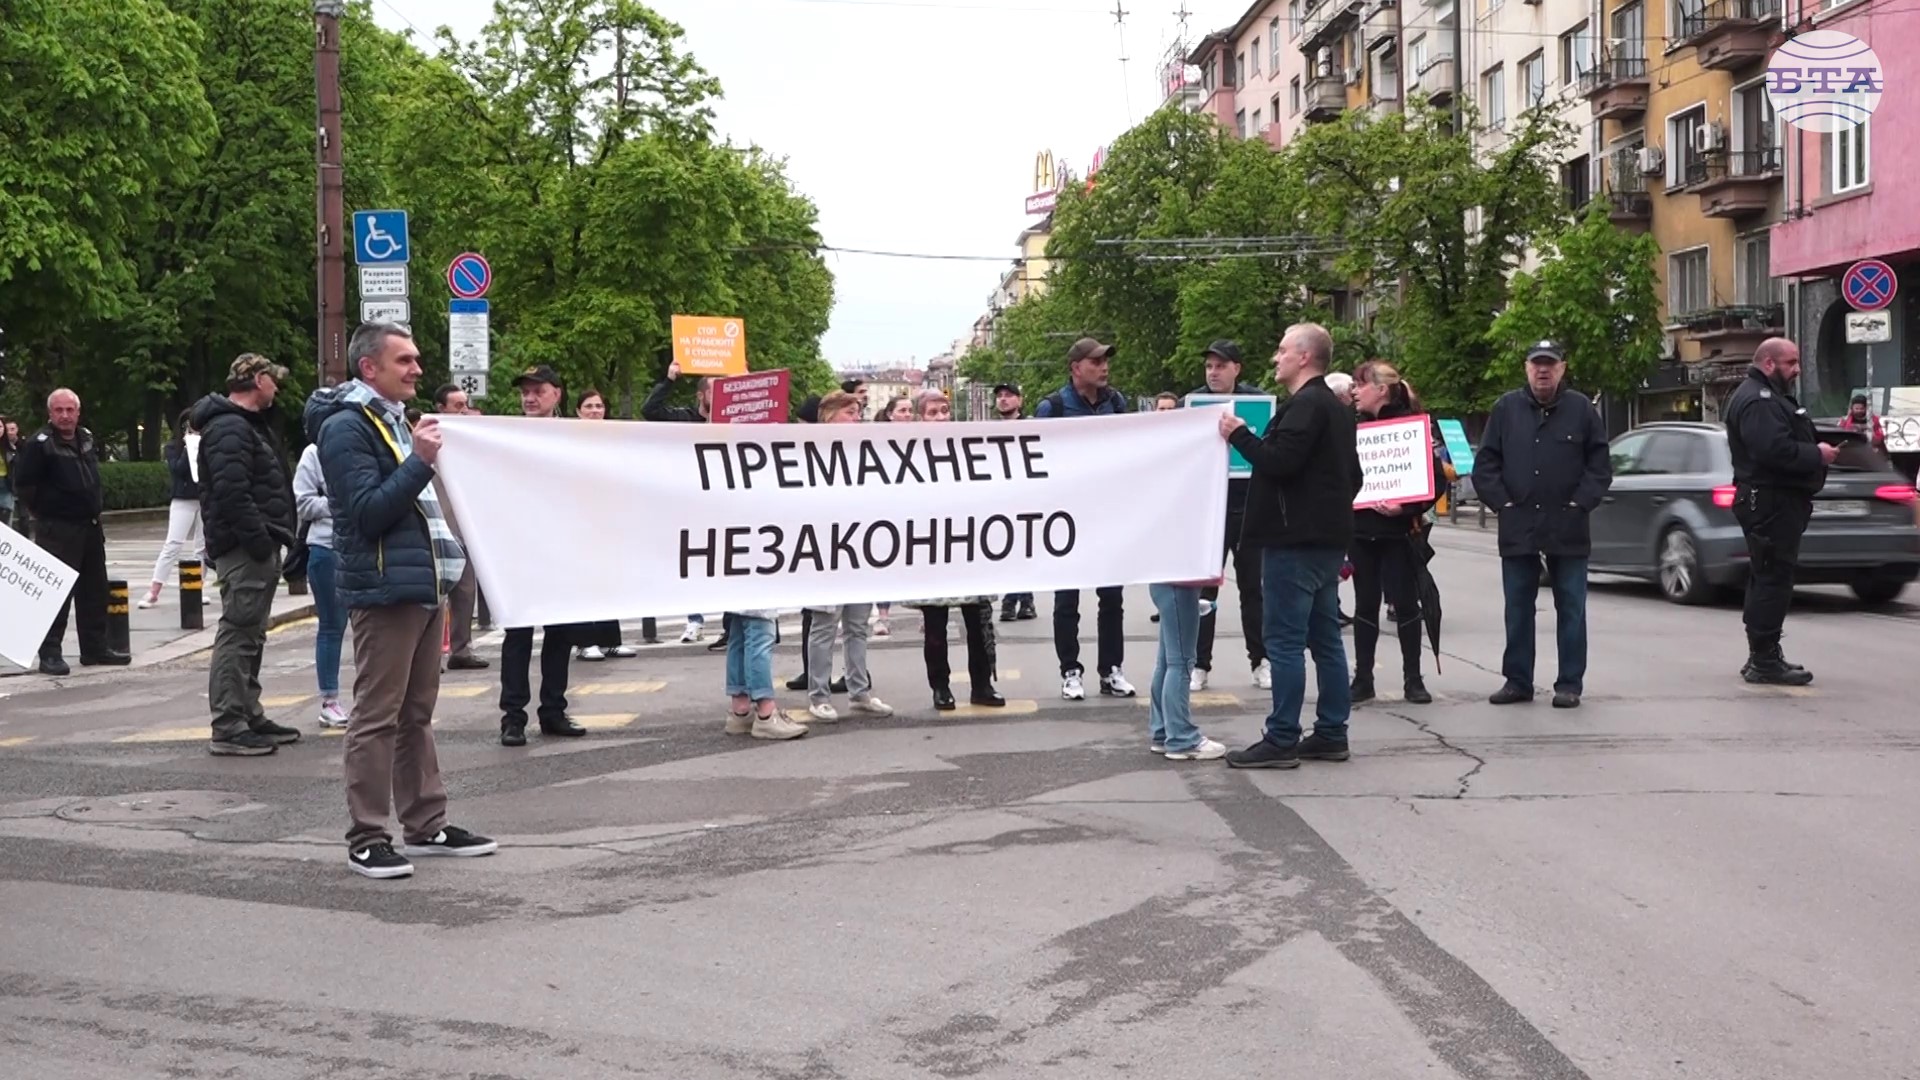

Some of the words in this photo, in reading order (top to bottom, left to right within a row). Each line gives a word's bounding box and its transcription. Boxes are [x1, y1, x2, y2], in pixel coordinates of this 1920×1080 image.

[697, 326, 717, 335] СТОП
[679, 336, 691, 345] НА
[691, 336, 735, 347] ГРАБЕЖИТЕ
[684, 347, 691, 356] В
[691, 348, 732, 358] СТОЛИЧНА
[691, 359, 724, 368] ОБЩИНА
[723, 376, 779, 393] БЕЗЗАКОНИЕТО
[726, 399, 774, 416] КОРУПЦИЯТА
[1358, 432, 1400, 446] РАВЕТЕ
[1402, 429, 1418, 441] ОТ
[1358, 446, 1410, 462] ЛЕВАРДИ
[694, 434, 1049, 491] ПРЕМАХНЕТЕ
[1363, 462, 1412, 476] РТАЛНИ
[1364, 478, 1402, 492] ЛИЦИ!
[679, 510, 1076, 578] НЕЗАКОННОТО
[0, 540, 13, 557] Ф
[12, 550, 64, 591] НАНСЕН
[0, 562, 44, 601] СОЧЕН
